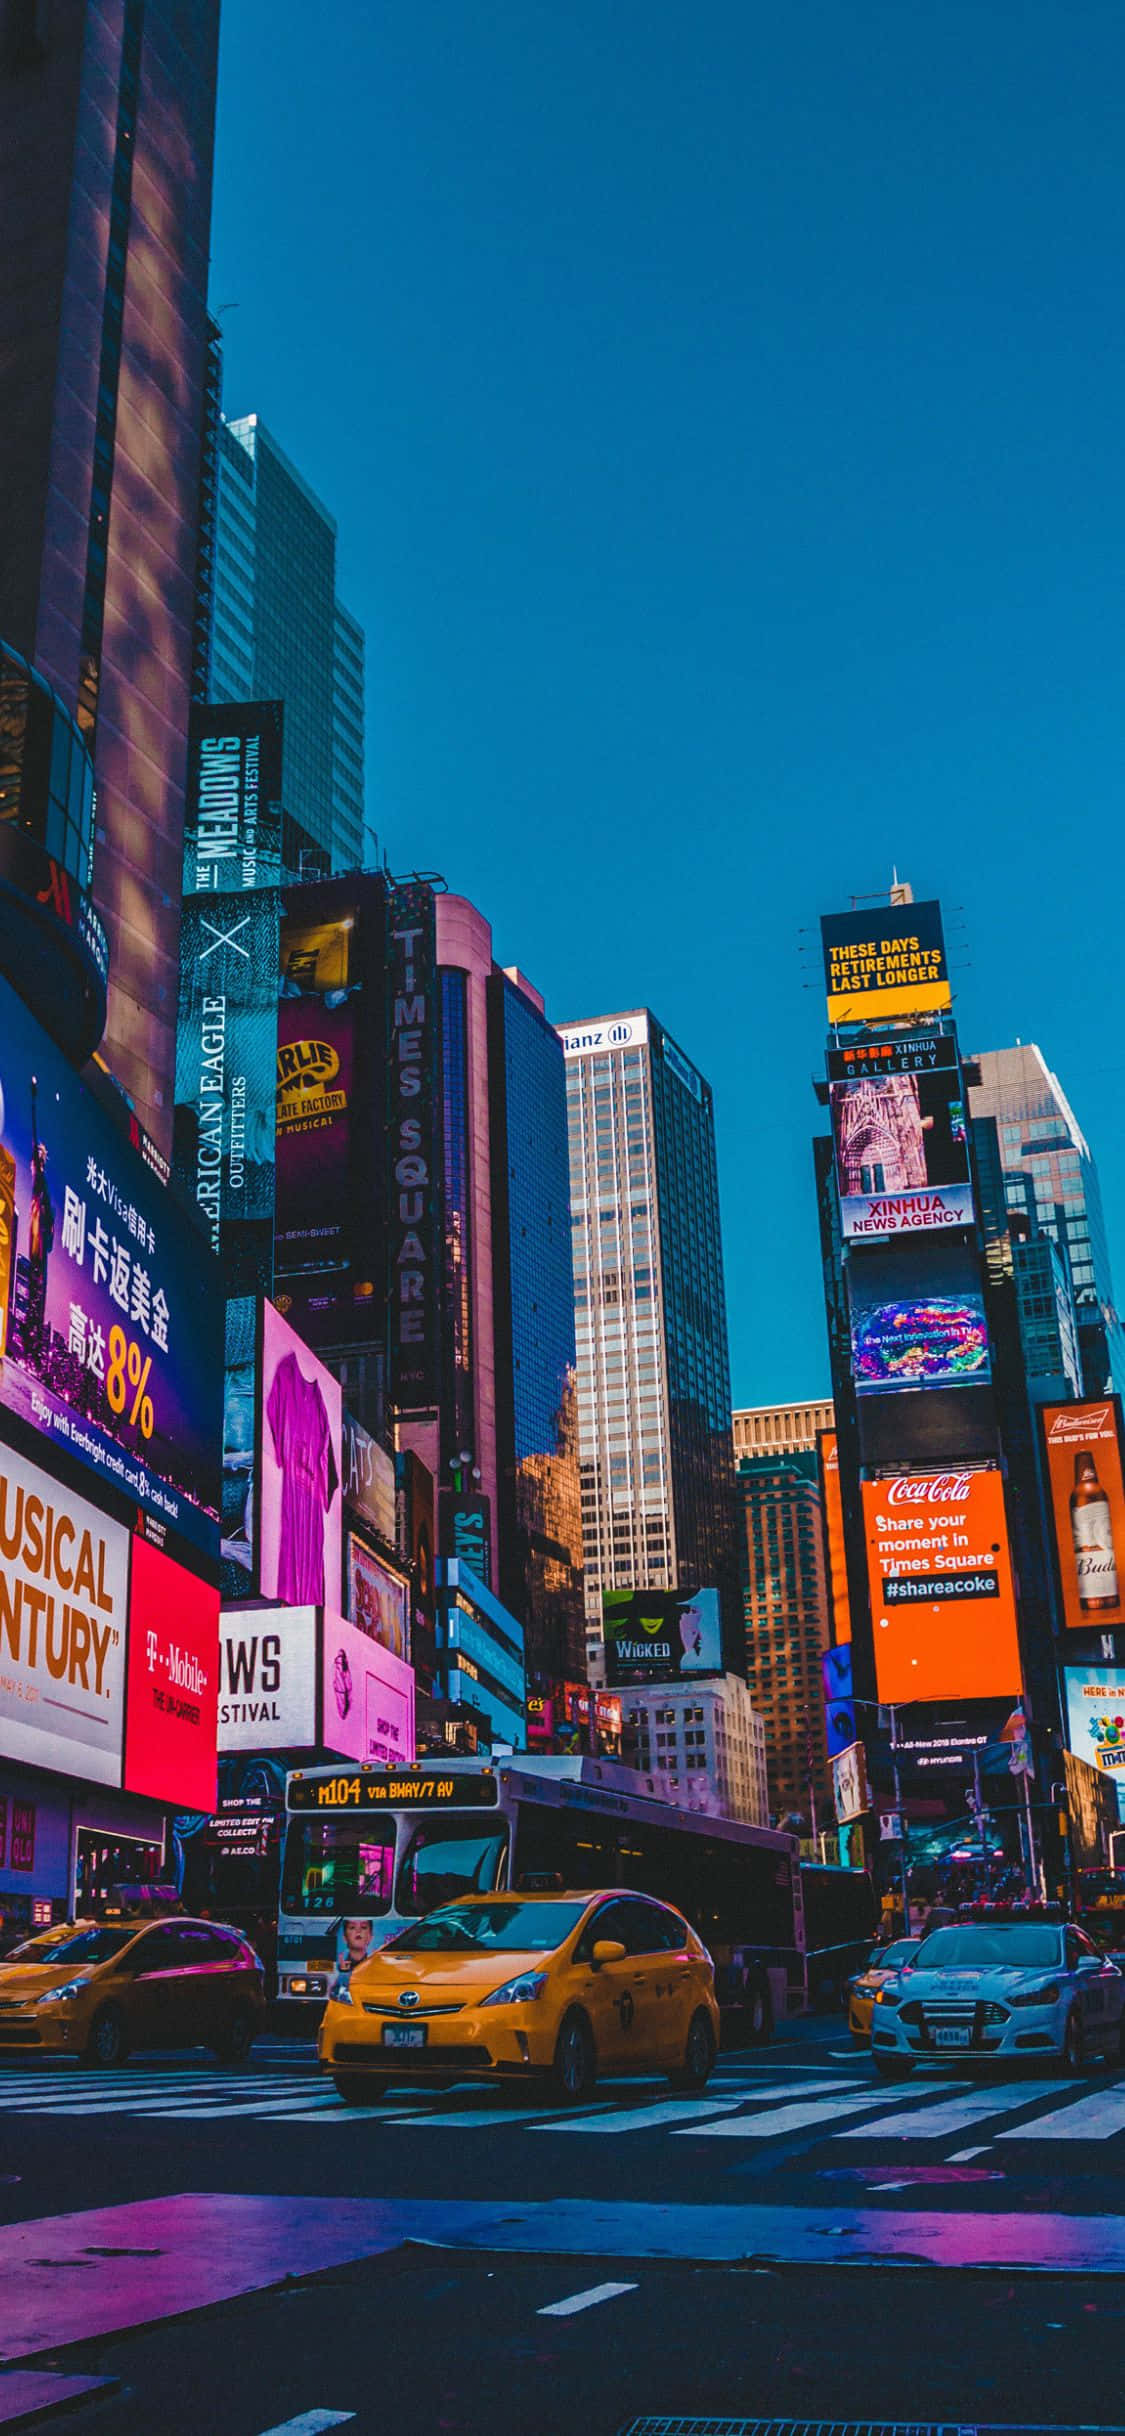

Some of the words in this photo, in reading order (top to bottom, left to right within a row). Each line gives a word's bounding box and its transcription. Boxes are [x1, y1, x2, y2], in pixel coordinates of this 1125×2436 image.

[244, 736, 260, 790] FESTIVAL
[197, 736, 241, 859] MEADOWS
[244, 794, 259, 824] ARTS
[196, 865, 210, 890] THE
[242, 848, 256, 888] MUSIC
[830, 943, 876, 961] THESE
[881, 937, 920, 955] DAYS
[830, 949, 941, 977] RETIREMENTS
[831, 975, 871, 992] LAST
[877, 966, 939, 986] LONGER
[393, 929, 425, 1097] TIMES
[200, 995, 226, 1093] EAGLE
[565, 1033, 603, 1050] ianz
[896, 1041, 936, 1055] XINHUA
[847, 1054, 937, 1075] GALLERY
[301, 1093, 343, 1113] FACTORY
[229, 1076, 247, 1188] OUTFITTERS
[286, 1118, 333, 1134] MUSICAL
[869, 1195, 945, 1217] XINHUA
[395, 1119, 429, 1343] SQUARE
[853, 1217, 897, 1233] NEWS
[901, 1209, 963, 1227] AGENCY
[61, 1185, 170, 1353] 刷卡返美金
[31, 1392, 52, 1426] Enjoy
[53, 1413, 70, 1437] with
[71, 1423, 105, 1463] Everbright
[106, 1454, 124, 1478] credit
[888, 1473, 973, 1505] Coca-Cola
[877, 1515, 923, 1532] Share
[929, 1513, 966, 1531] your
[878, 1535, 948, 1552] moment
[953, 1533, 968, 1547] in
[880, 1552, 930, 1572] Times
[934, 1552, 995, 1570] Square
[887, 1576, 996, 1597] #shareacoke
[218, 1635, 280, 1695] WS
[1083, 1686, 1107, 1697] HERE
[222, 1799, 244, 1807] SHOP
[246, 1798, 261, 1806] THE
[318, 1778, 360, 1804] M104
[368, 1787, 386, 1799] VIA
[389, 1781, 433, 1798] BWAY/7
[437, 1781, 453, 1797] AV
